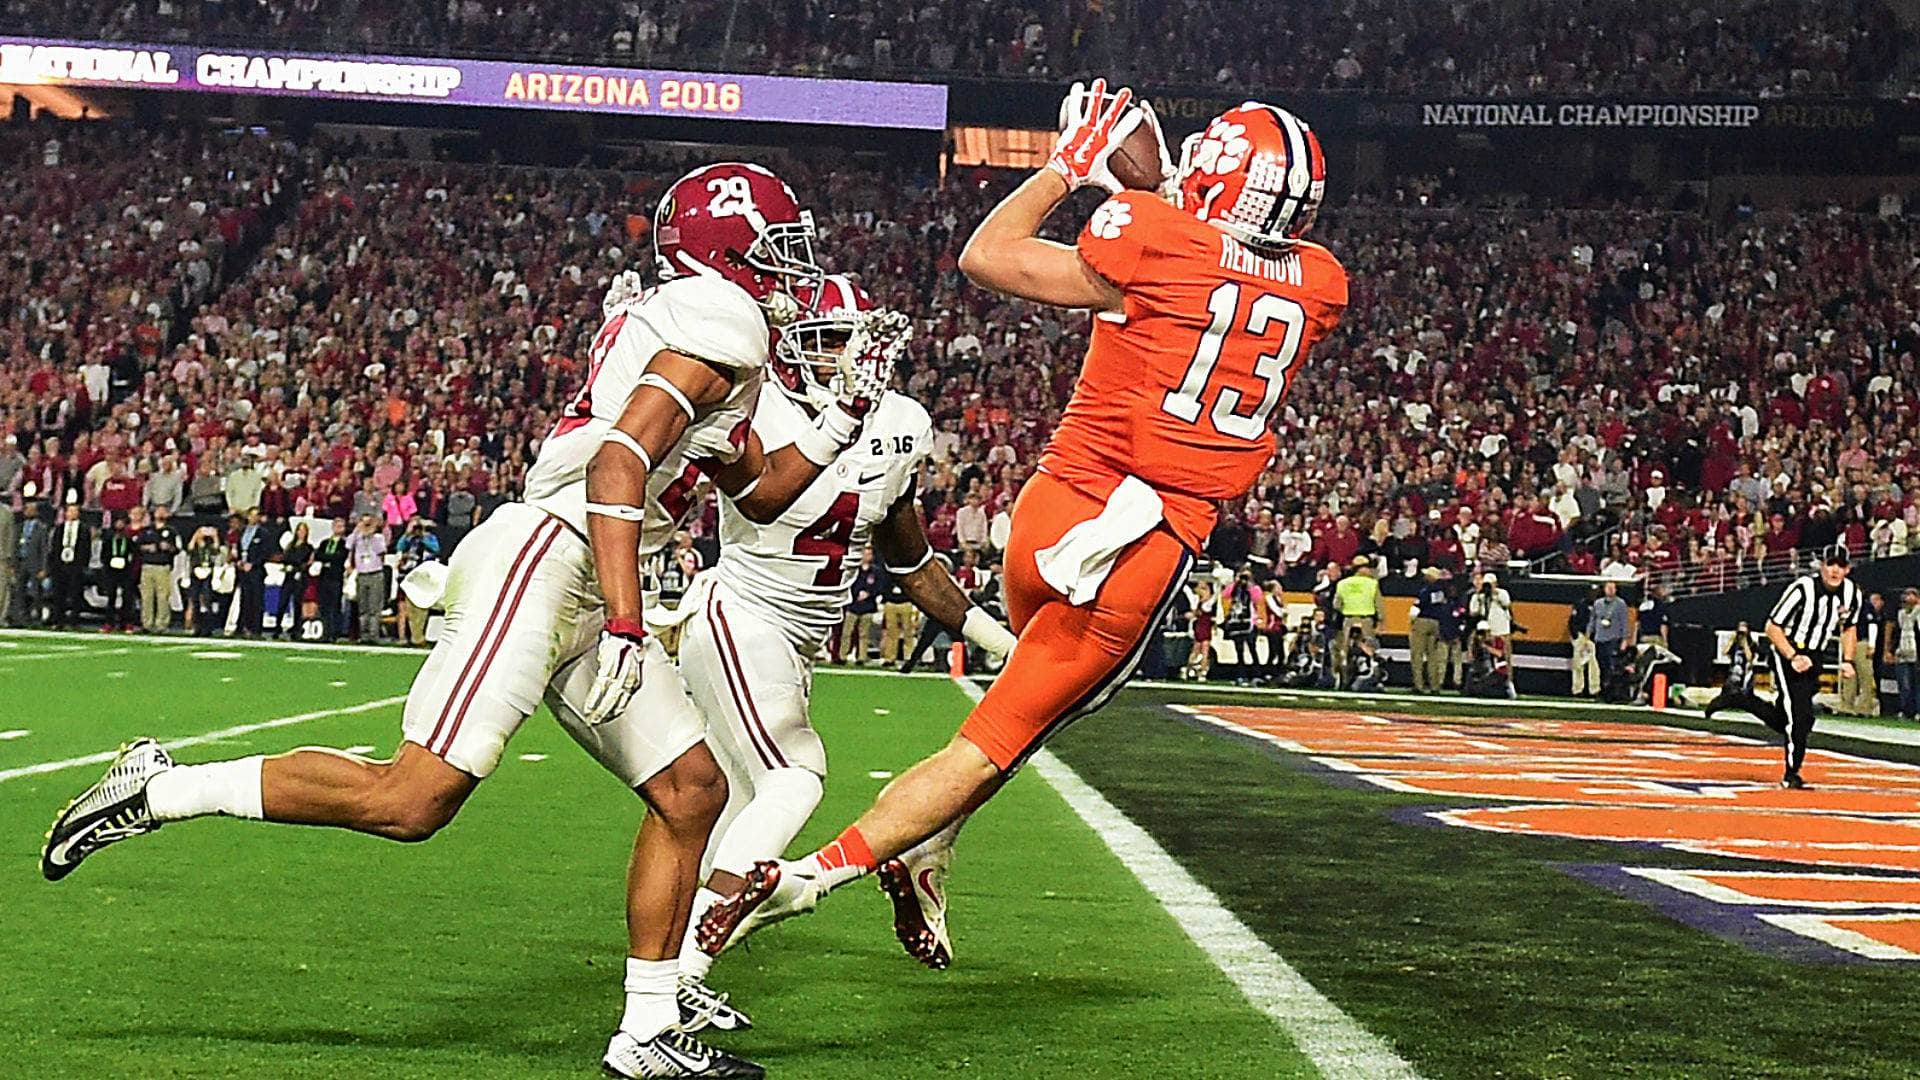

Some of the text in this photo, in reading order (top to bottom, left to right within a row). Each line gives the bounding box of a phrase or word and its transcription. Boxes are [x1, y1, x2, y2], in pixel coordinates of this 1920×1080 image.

[0, 44, 742, 112] NATIONAL CHAMPIONSHIP ARIZONA 2016
[1422, 104, 1553, 127] NATIONAL
[1557, 104, 1760, 127] CHAMPIONSHIP
[706, 175, 753, 219] 29
[1161, 280, 1306, 441] 13
[869, 434, 915, 457] 216
[791, 490, 861, 587] 4
[301, 620, 324, 640] 10
